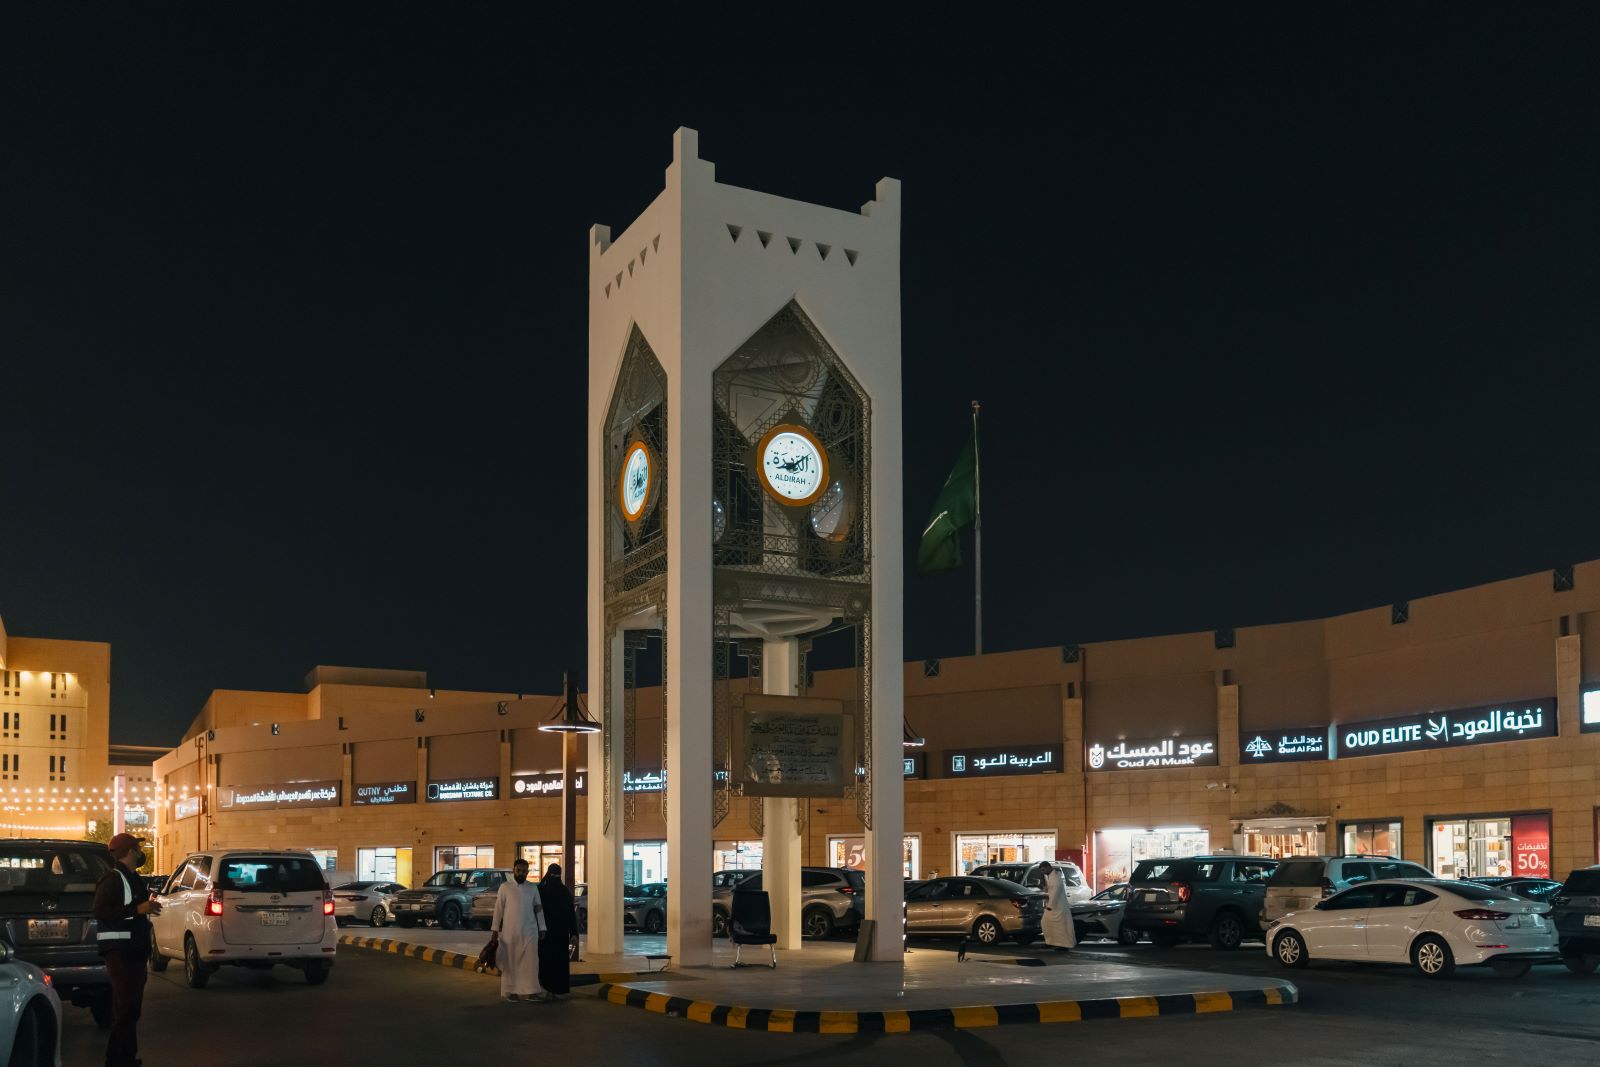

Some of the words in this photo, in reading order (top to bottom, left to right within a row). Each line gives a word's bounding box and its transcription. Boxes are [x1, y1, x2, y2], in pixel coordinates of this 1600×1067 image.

[774, 473, 806, 485] ALDIRAH
[1452, 710, 1501, 740] العود
[1503, 708, 1542, 735] نخبة
[1306, 736, 1323, 745] عود
[1345, 730, 1380, 748] OUD
[1382, 724, 1422, 744] ELITE
[1106, 739, 1174, 760] المسك
[1179, 740, 1214, 759] عود
[1278, 746, 1296, 754] Oud
[1307, 745, 1323, 753] Faal
[973, 754, 1007, 769] للعود
[1009, 751, 1052, 767] العربية
[1117, 759, 1145, 768] Oud
[1146, 759, 1161, 767] Al
[1162, 757, 1195, 766] Musk
[357, 787, 381, 796] QUTNY
[384, 784, 408, 796] قطني
[1517, 842, 1548, 852] تخفيضات
[1518, 853, 1548, 870] 50%
